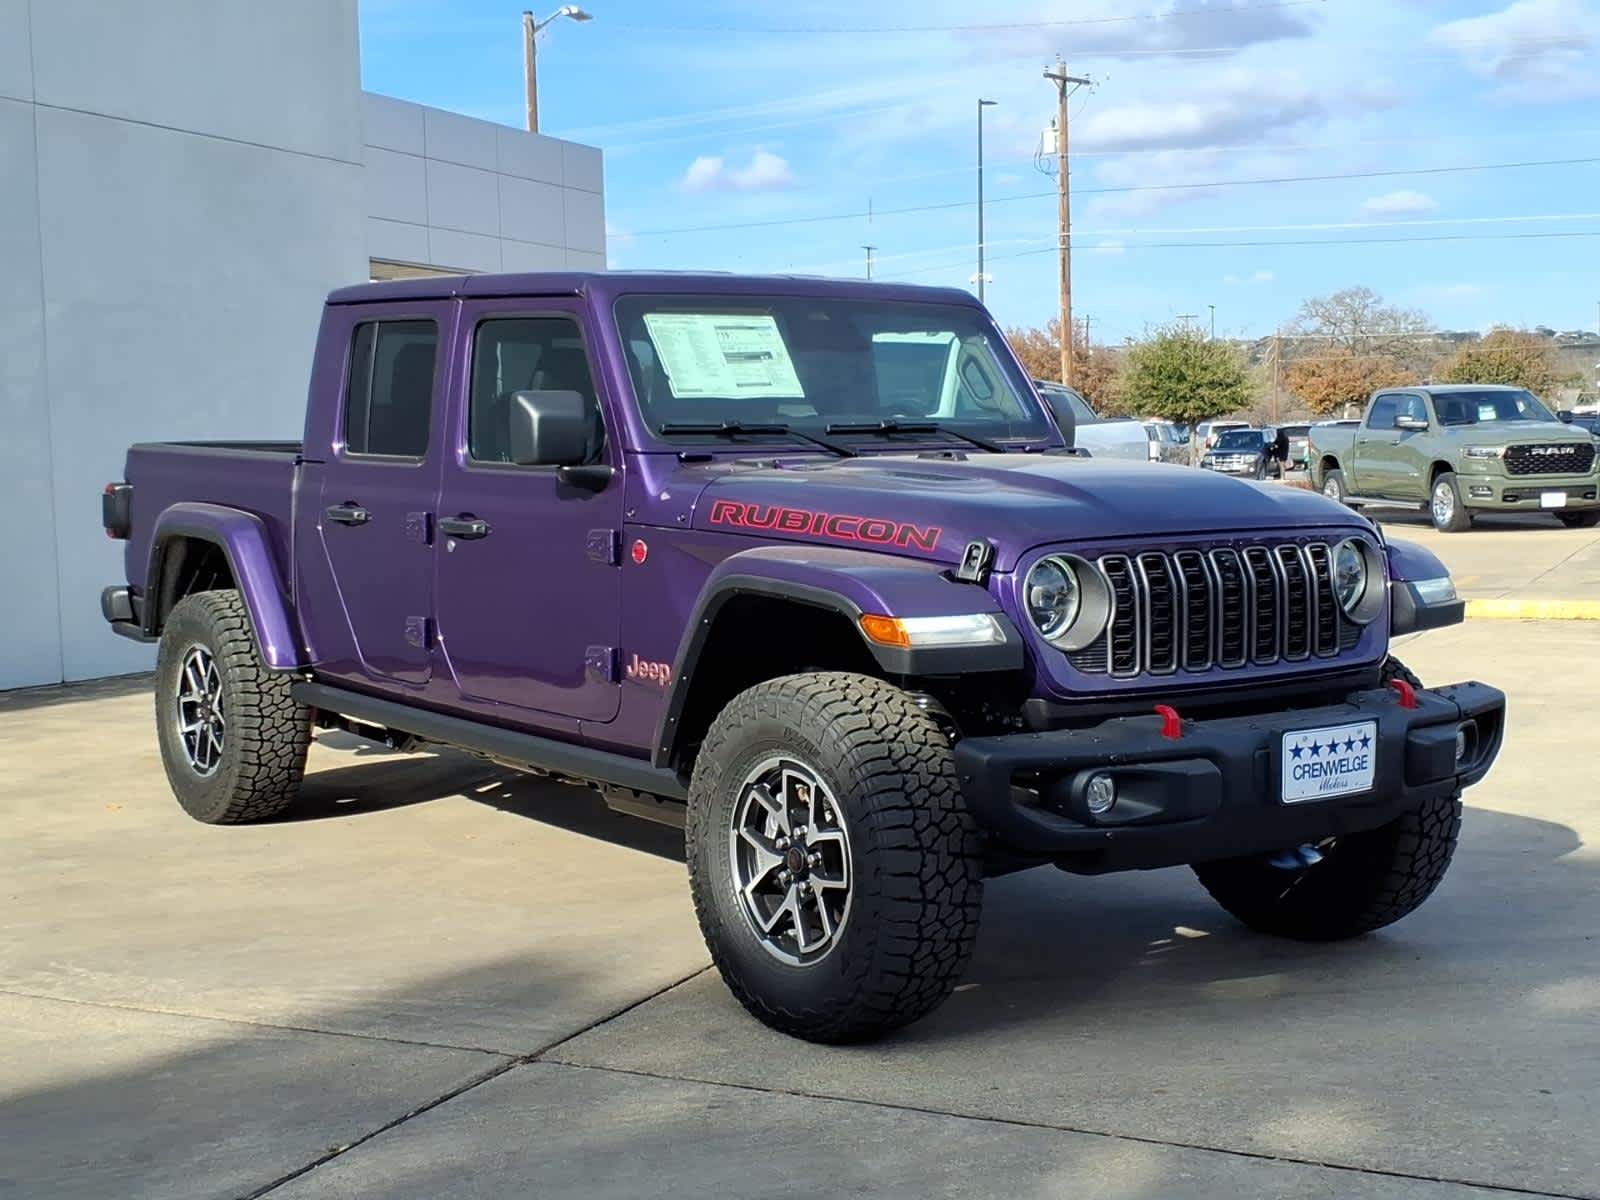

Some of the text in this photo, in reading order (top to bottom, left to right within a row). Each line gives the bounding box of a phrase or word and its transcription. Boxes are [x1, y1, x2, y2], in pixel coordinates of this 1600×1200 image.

[1531, 447, 1575, 455] RAM
[710, 500, 942, 551] RUBICON
[626, 654, 671, 687] Jeep
[1293, 755, 1368, 781] CRENWELGE
